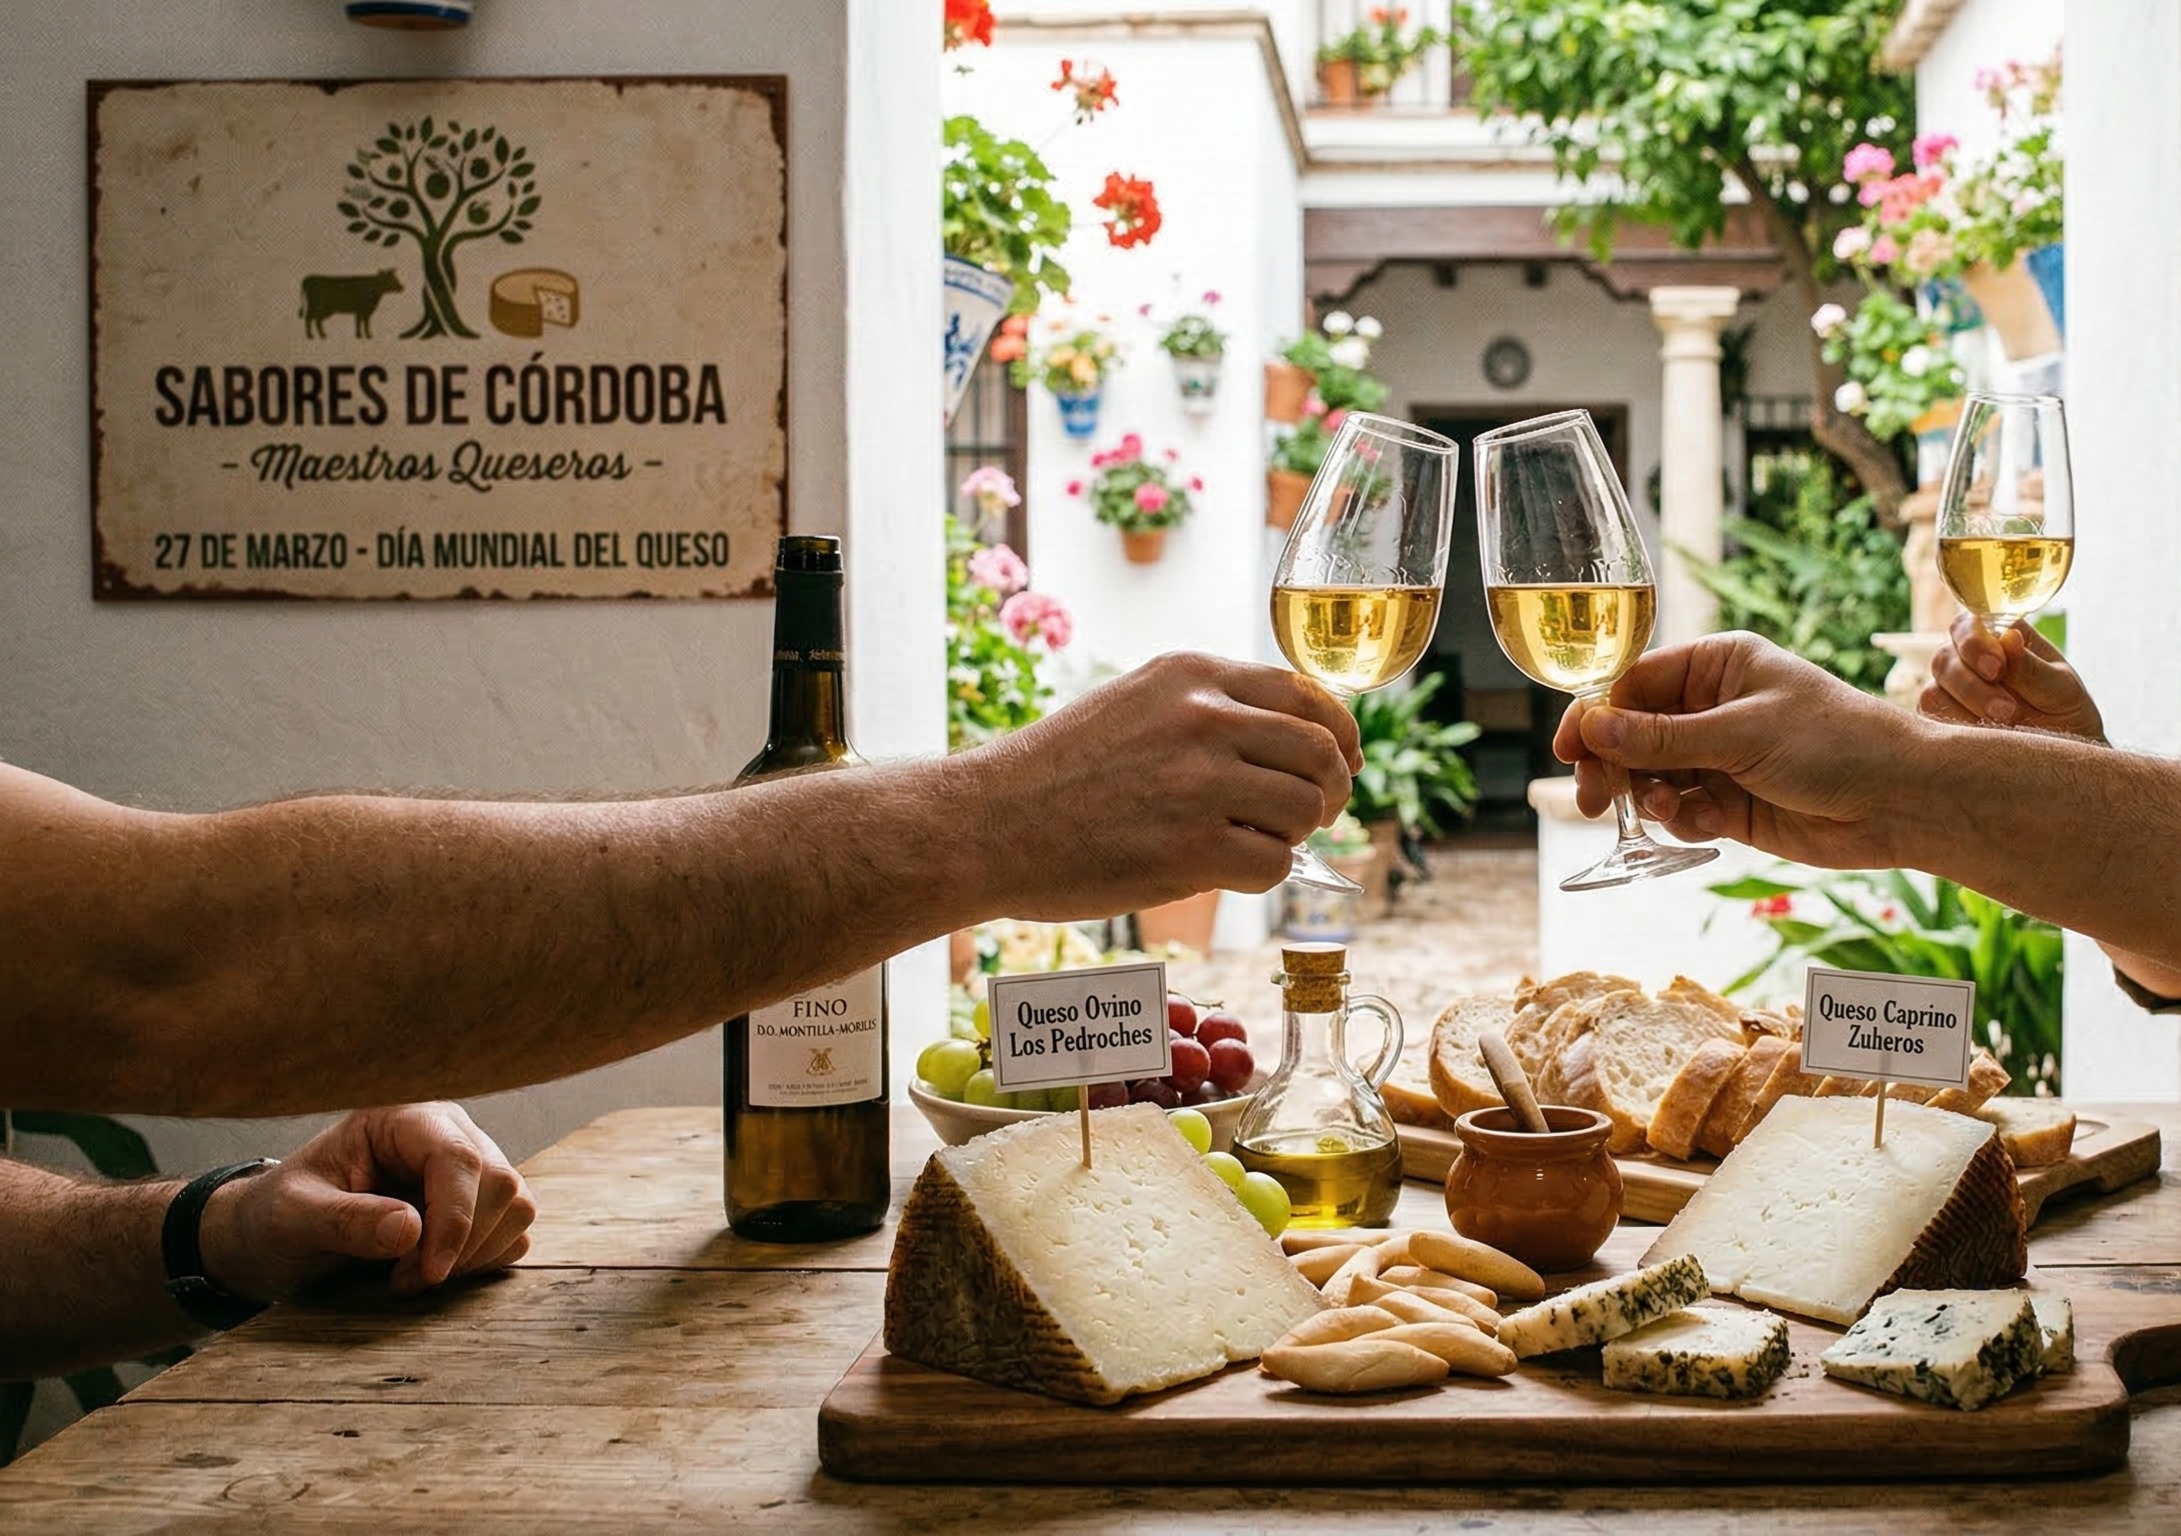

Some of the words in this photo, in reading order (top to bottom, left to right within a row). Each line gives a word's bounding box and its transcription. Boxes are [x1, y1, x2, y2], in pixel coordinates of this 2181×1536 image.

[155, 365, 389, 427] SABORES
[405, 365, 469, 426] DE
[485, 351, 728, 426] CÓRDOBA
[250, 442, 444, 491] Maestros
[447, 439, 633, 494] Queseros
[154, 532, 192, 570] 27
[200, 532, 238, 570] DE
[246, 532, 348, 569] MARZO
[376, 525, 426, 569] DÍA
[432, 531, 566, 569] MUNDIAL
[573, 531, 628, 568] DEL
[636, 531, 730, 569] QUESO
[793, 998, 848, 1018] FINO
[1017, 1001, 1079, 1029] Queso
[1085, 994, 1142, 1020] Ovino
[1819, 993, 1877, 1022] Queso
[1883, 999, 1957, 1030] Caprino
[1010, 1032, 1046, 1057] Los
[1051, 1022, 1153, 1054] Pedroches
[1848, 1024, 1924, 1054] Zuheros
